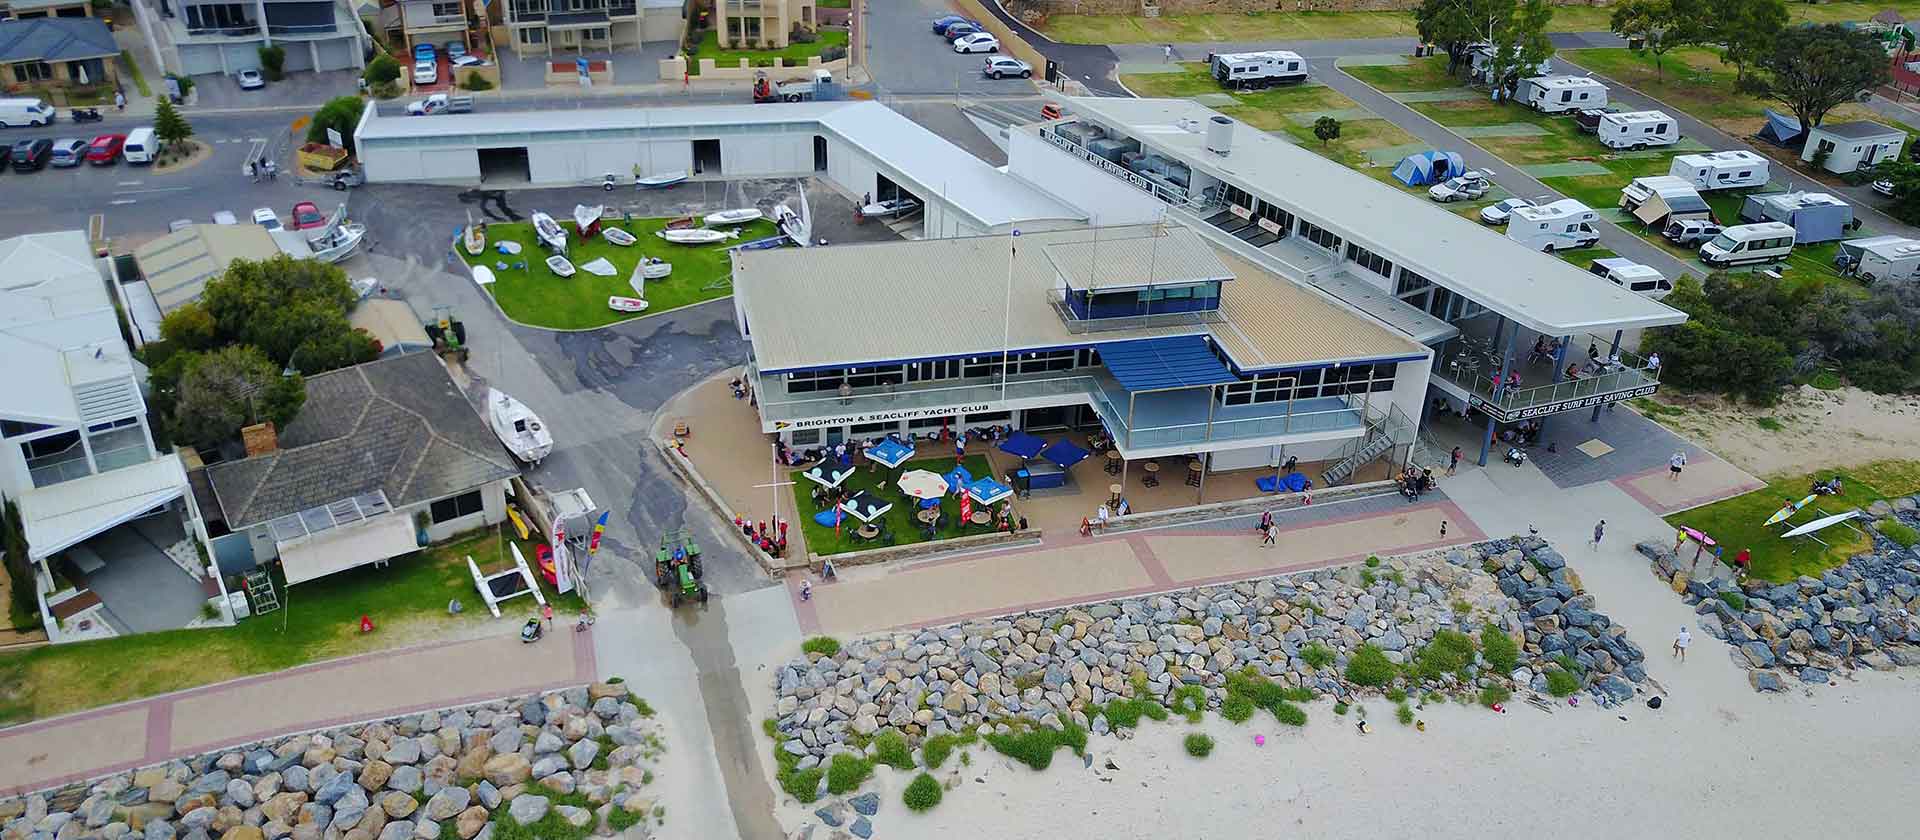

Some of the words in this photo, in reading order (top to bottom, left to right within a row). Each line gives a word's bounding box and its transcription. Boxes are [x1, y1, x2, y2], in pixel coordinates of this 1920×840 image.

[1130, 174, 1147, 189] CLUB
[1521, 403, 1562, 418] SEACLIFF
[1562, 400, 1584, 412] SURF
[1584, 396, 1603, 407] LIFE
[1603, 391, 1633, 403] SAVING
[1634, 386, 1656, 397] CLUB
[796, 417, 854, 428] BRIGHTON
[869, 410, 919, 421] SEACLIFF
[923, 407, 958, 416] YACHT
[961, 404, 989, 412] CLUB
